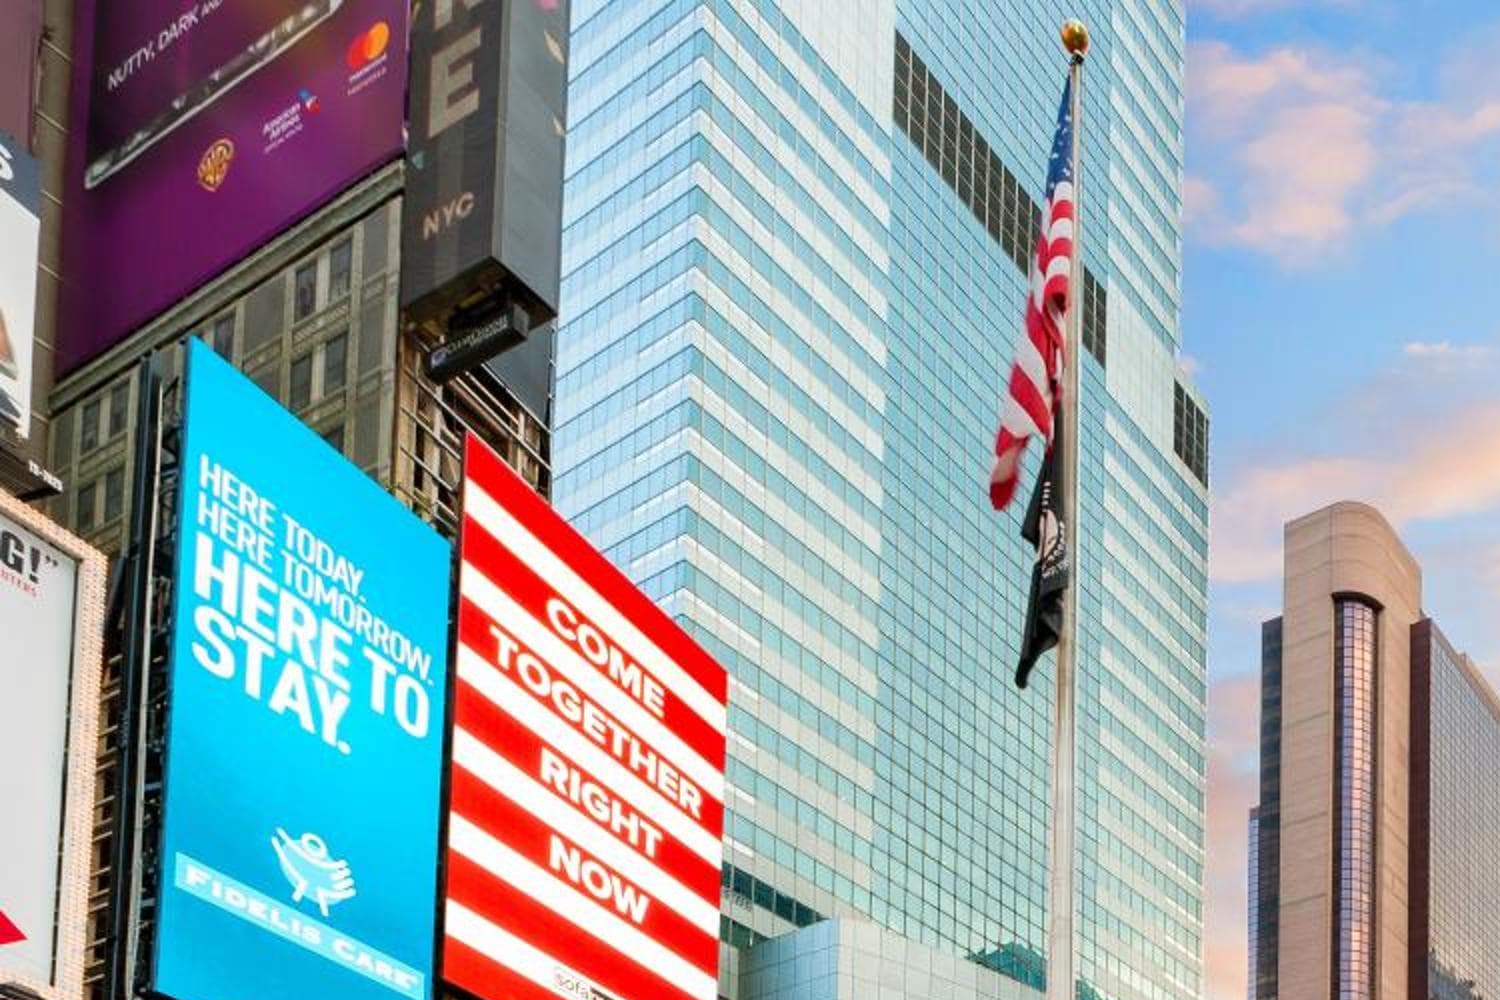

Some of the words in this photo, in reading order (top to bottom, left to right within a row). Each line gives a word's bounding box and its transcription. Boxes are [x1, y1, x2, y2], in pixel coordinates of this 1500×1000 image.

[107, 41, 155, 91] NUTTY,
[157, 7, 200, 50] DARK
[422, 191, 475, 241] NYC
[197, 493, 275, 573] HERE
[199, 454, 276, 538] HERE
[191, 604, 352, 756] STAY.
[193, 532, 353, 694] HERE
[362, 646, 431, 740] TO
[546, 596, 666, 719] COME
[490, 624, 703, 823] TOGETHER
[539, 745, 664, 859] RIGHT
[184, 862, 322, 946] FIDELIS
[332, 937, 419, 991] CARE
[548, 832, 650, 927] NOW
